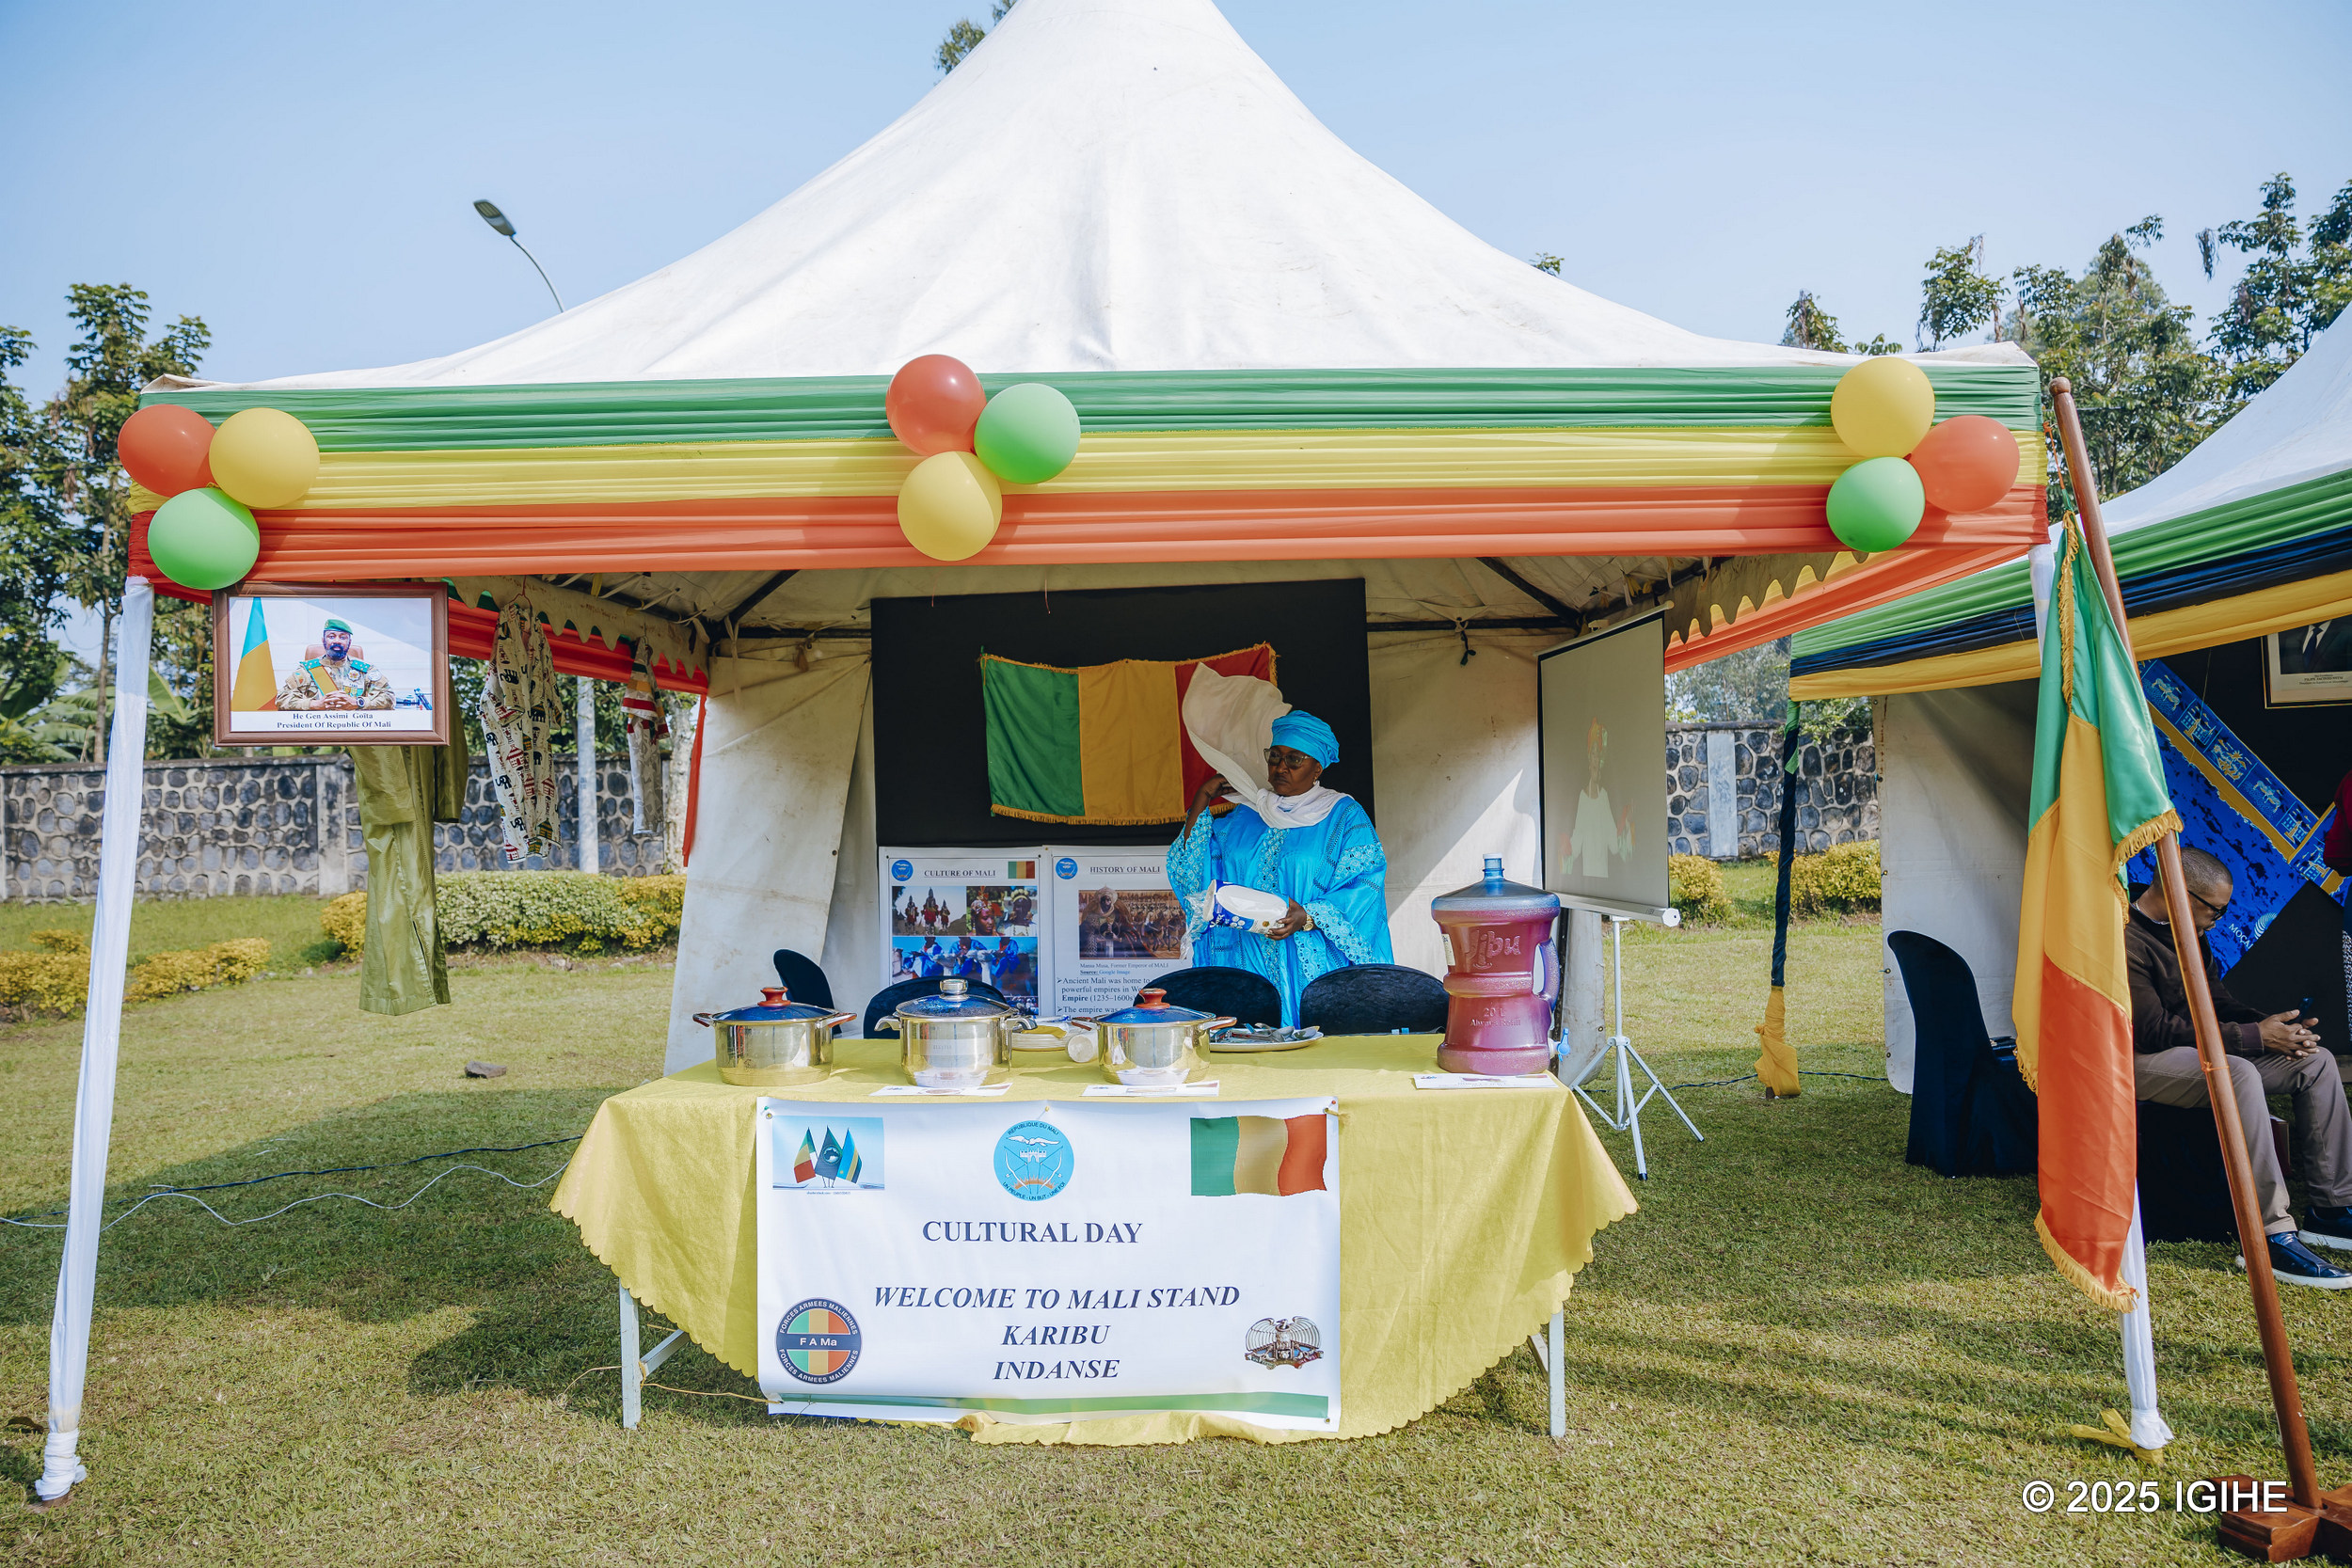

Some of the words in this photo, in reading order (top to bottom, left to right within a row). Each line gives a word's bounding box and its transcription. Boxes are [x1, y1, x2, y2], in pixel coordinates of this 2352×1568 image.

[326, 721, 360, 730] Republic
[1465, 929, 1521, 965] Jibu
[1008, 1121, 1039, 1135] REPUBLIQUE
[1047, 1126, 1059, 1135] MALI
[1007, 1187, 1025, 1199] PEUPLE
[1049, 1188, 1059, 1196] UNE
[1057, 1181, 1066, 1191] FOI
[922, 1220, 1078, 1243] CULTURAL
[1084, 1222, 1143, 1243] DAY
[874, 1286, 1016, 1308] WELCOME
[1025, 1288, 1060, 1309] TO
[1065, 1290, 1142, 1309] MALI
[1146, 1285, 1240, 1308] STAND
[779, 1307, 799, 1334] FORCES
[799, 1300, 828, 1310] ARMEES
[828, 1303, 858, 1335] MALIENNES
[1001, 1324, 1111, 1346] KARIBU
[779, 1348, 798, 1375] FORCES
[798, 1372, 828, 1383] ARMEES
[829, 1349, 859, 1382] MALIENNES
[992, 1359, 1120, 1381] INDANSE
